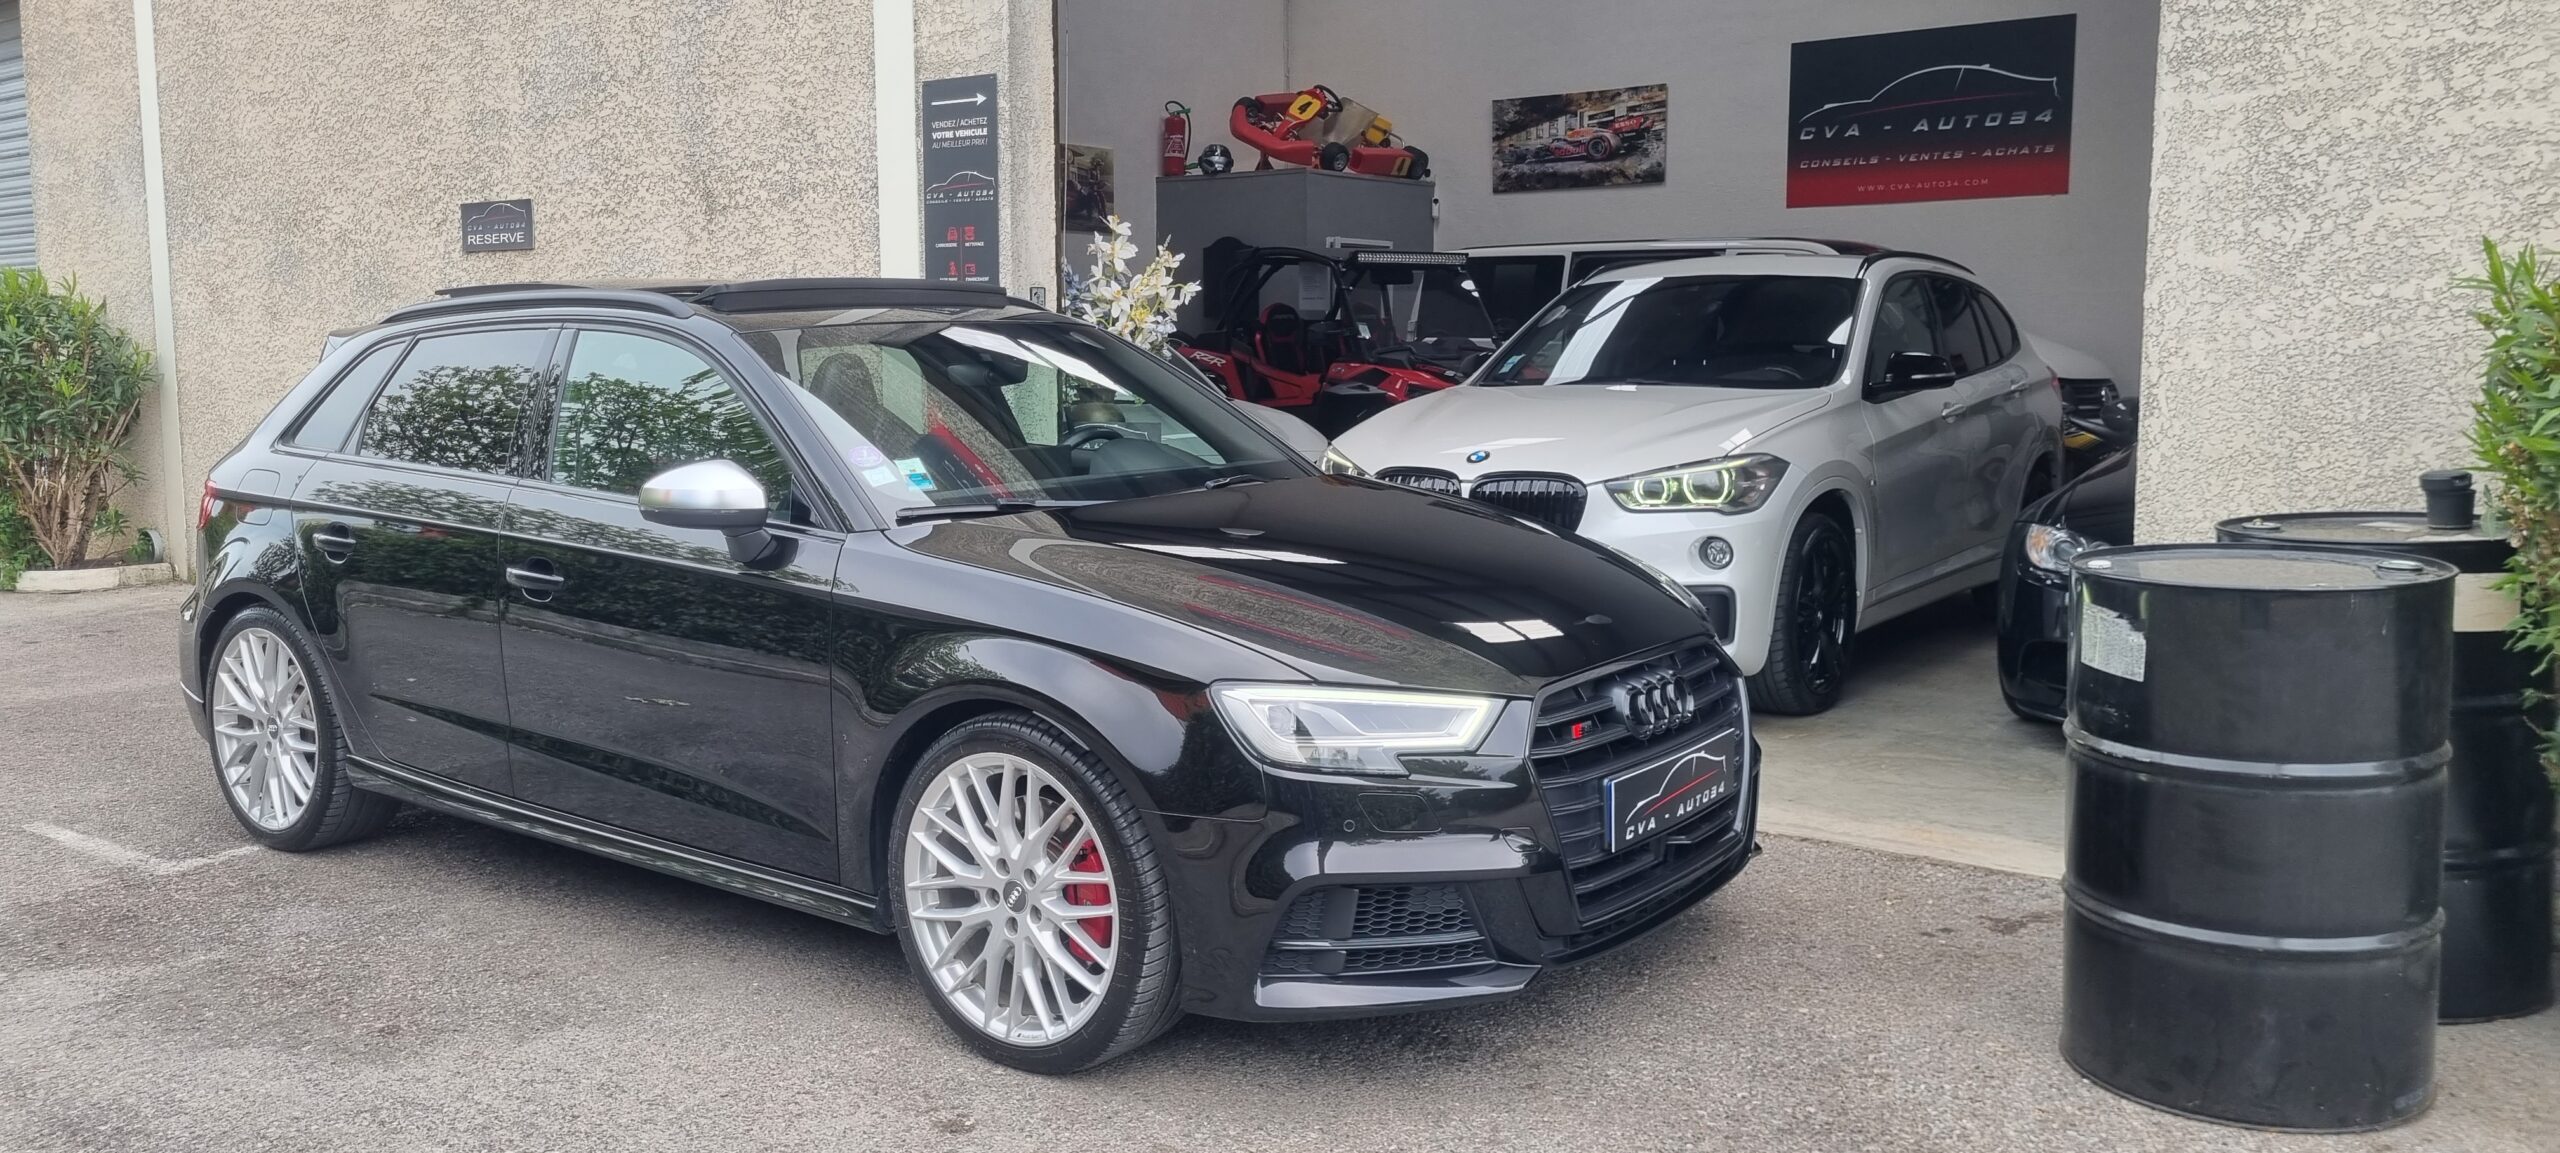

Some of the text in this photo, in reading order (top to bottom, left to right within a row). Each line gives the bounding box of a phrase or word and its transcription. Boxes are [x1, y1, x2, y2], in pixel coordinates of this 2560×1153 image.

[1297, 101, 1313, 115] 4
[931, 120, 956, 129] VENDEZ
[960, 116, 987, 126] ACHETEZ
[1800, 123, 1860, 140] CVA
[1912, 109, 2053, 132] AUTO34
[932, 130, 954, 140] VOTRE
[932, 140, 941, 149] AU
[942, 139, 971, 148] MEILLEUR
[1800, 156, 1879, 168] CONSEILS
[1899, 150, 1964, 163] VENTES
[1982, 144, 2056, 158] ACHATS
[926, 192, 944, 200] CVA
[467, 231, 526, 245] RESERVE
[1190, 351, 1227, 367] RZR
[1625, 817, 1656, 840] CVA
[1677, 781, 1725, 817] AUTO34
